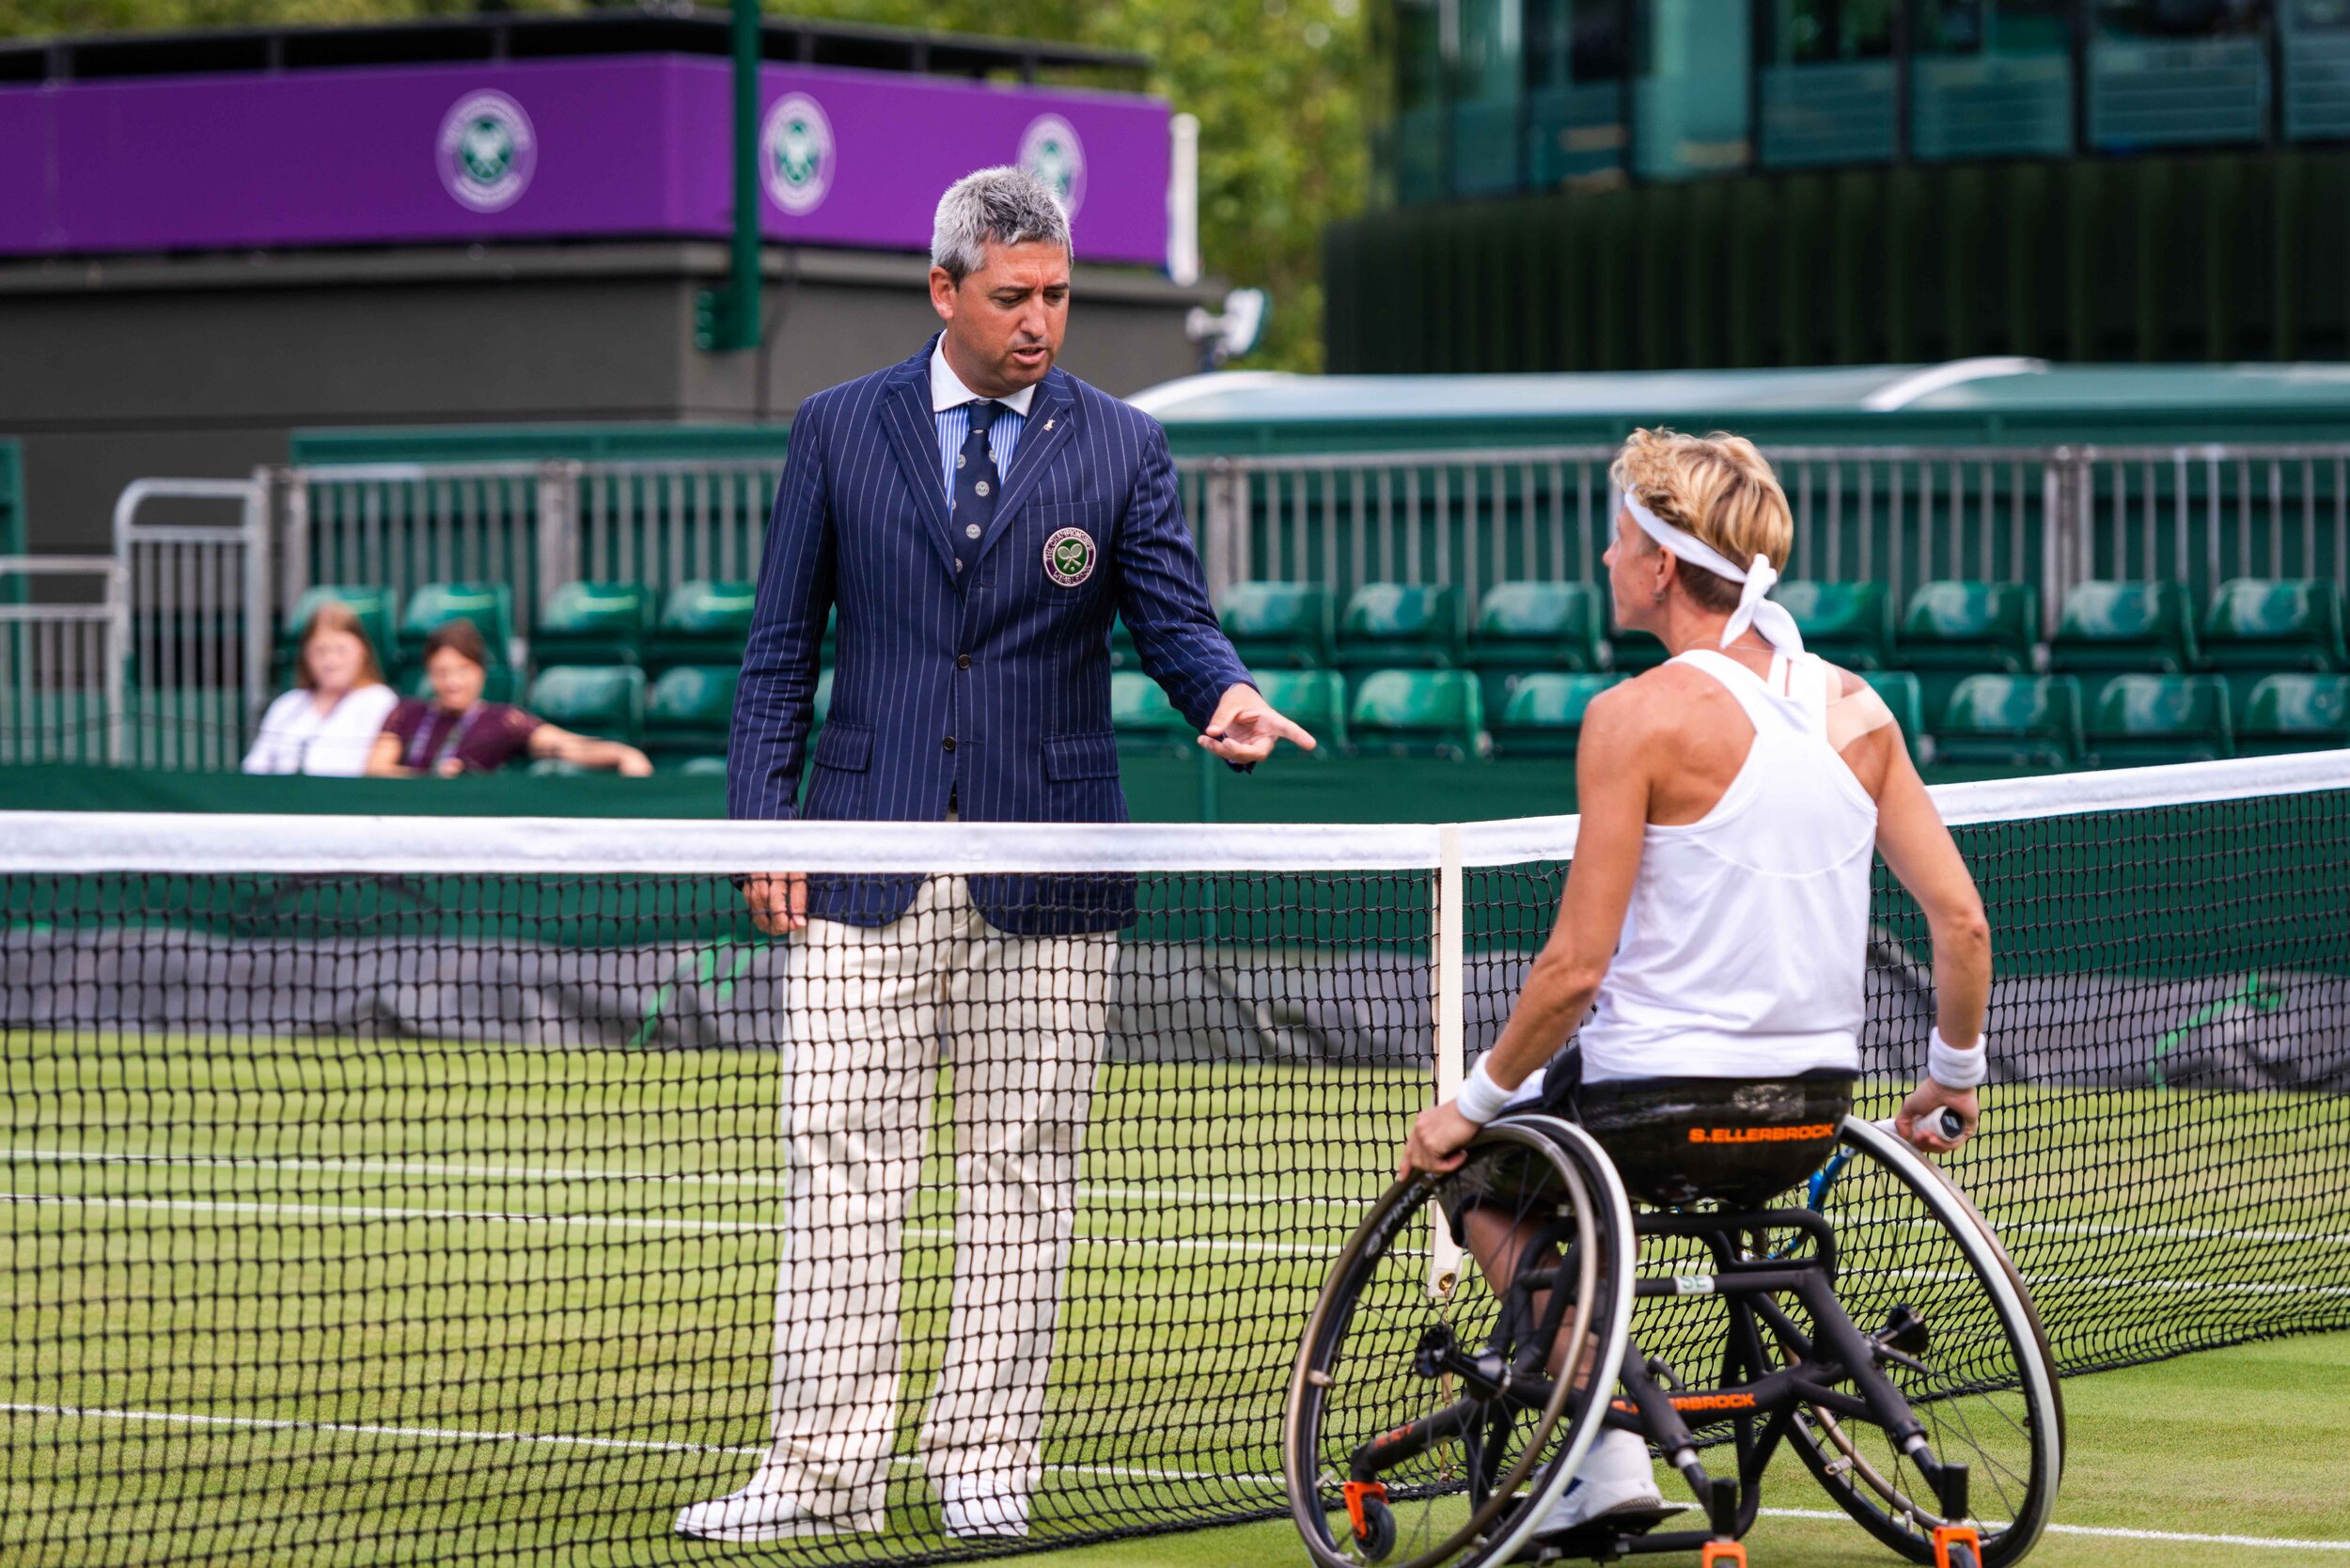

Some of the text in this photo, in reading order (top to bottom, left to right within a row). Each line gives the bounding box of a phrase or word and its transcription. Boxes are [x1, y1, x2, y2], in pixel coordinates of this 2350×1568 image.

[1045, 529, 1094, 560] THE CHAMPIONSHIPS
[1053, 564, 1091, 584] WIMBLEDON
[1689, 1123, 1835, 1143] S.ELLERBROCK
